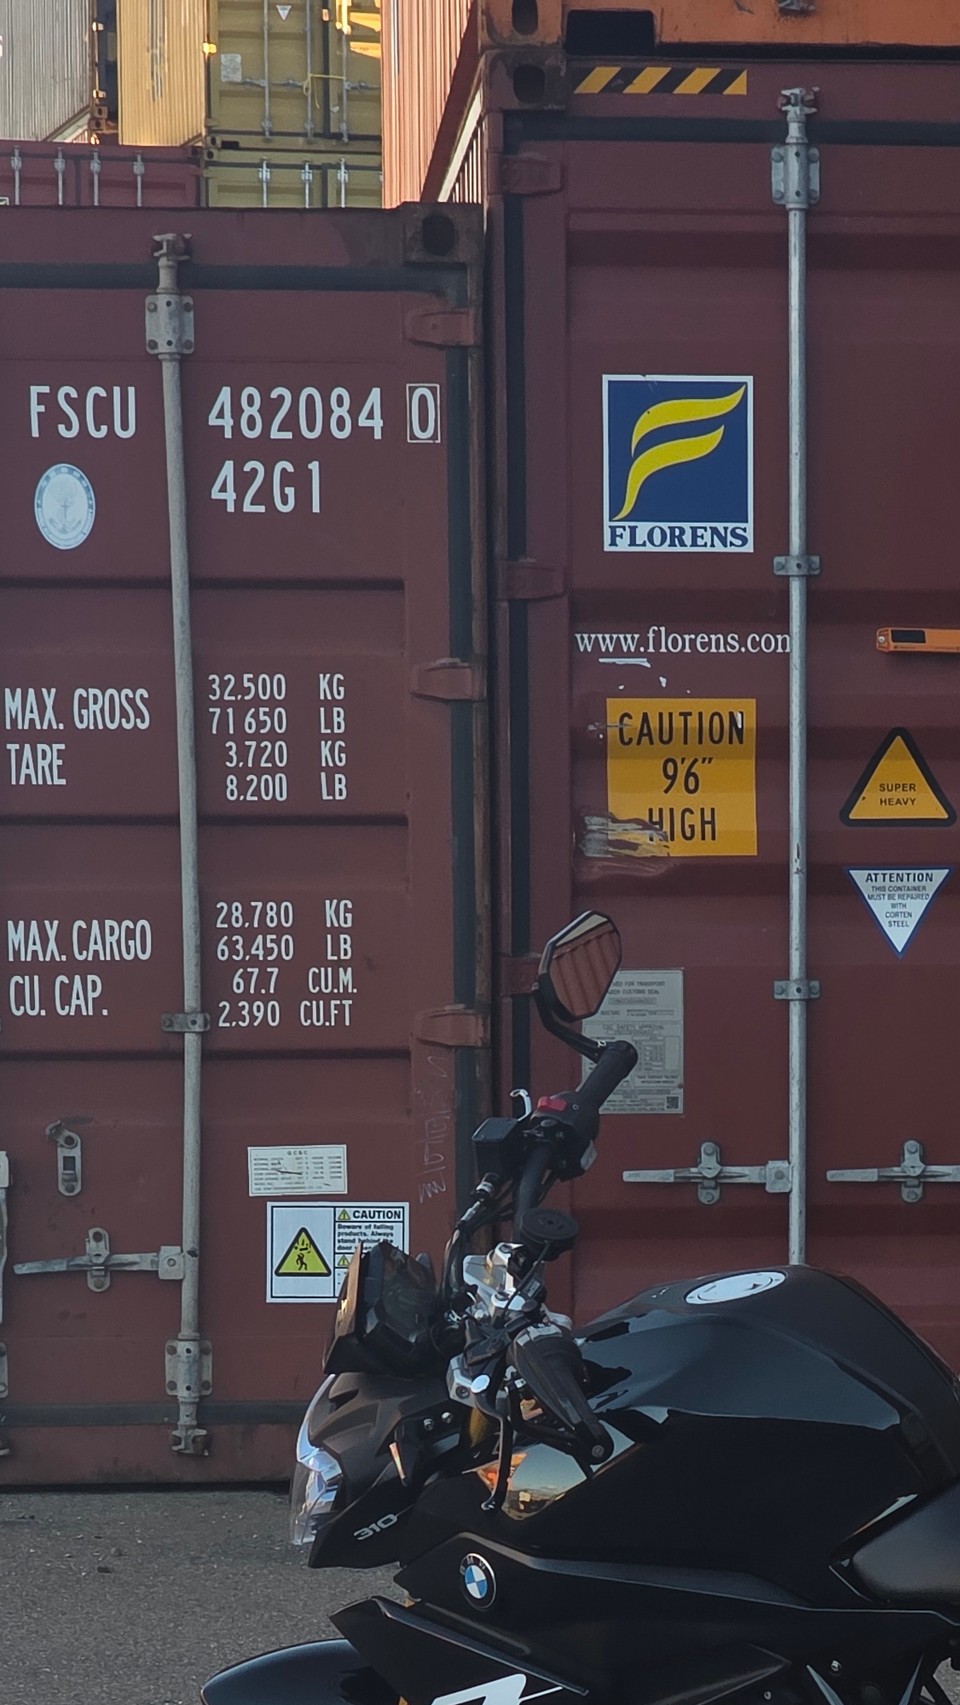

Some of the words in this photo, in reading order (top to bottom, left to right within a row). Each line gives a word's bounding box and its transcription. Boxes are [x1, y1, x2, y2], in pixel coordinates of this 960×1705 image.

[29, 385, 136, 439] FSCU
[208, 386, 384, 440] 482084
[411, 387, 436, 440] 0
[210, 460, 321, 514] 42G1
[608, 524, 749, 549] FLORENS
[208, 673, 286, 701] 32,500
[319, 673, 345, 700] KG
[4, 687, 65, 730] MAX.
[73, 687, 150, 730] GROSS
[319, 707, 345, 734] LB
[617, 710, 745, 746] CAUTION
[6, 743, 67, 786] TARE
[225, 740, 288, 768] 3,720
[320, 740, 346, 767] KG
[226, 772, 288, 802] 8,200
[320, 771, 347, 801] LB
[878, 782, 917, 793] SUPER
[879, 797, 917, 806] HEAVY
[648, 807, 717, 841] HIGH
[865, 872, 934, 883] ATTENTION
[871, 885, 887, 893] THIS
[887, 885, 928, 893] CONTAINER
[867, 893, 886, 901] MUST
[887, 893, 897, 901] BE
[897, 893, 930, 901] REPAIRED
[890, 902, 907, 910] WITH
[216, 901, 293, 928] 28,780
[325, 898, 353, 928] KG
[884, 911, 913, 919] CORTEN
[887, 920, 910, 928] STEEL
[7, 919, 67, 962] MAX.
[72, 919, 152, 961] CARGO
[217, 934, 294, 961] 63,450
[326, 934, 352, 961] LB
[232, 967, 279, 994] 67.7
[308, 966, 358, 994] CU.M.
[9, 974, 46, 1017] CU.
[54, 974, 108, 1016] CAP.
[218, 1000, 280, 1027] 2,390
[300, 999, 353, 1027] CU.FT
[352, 1210, 401, 1220] CAUTION
[353, 1513, 397, 1540] 310
